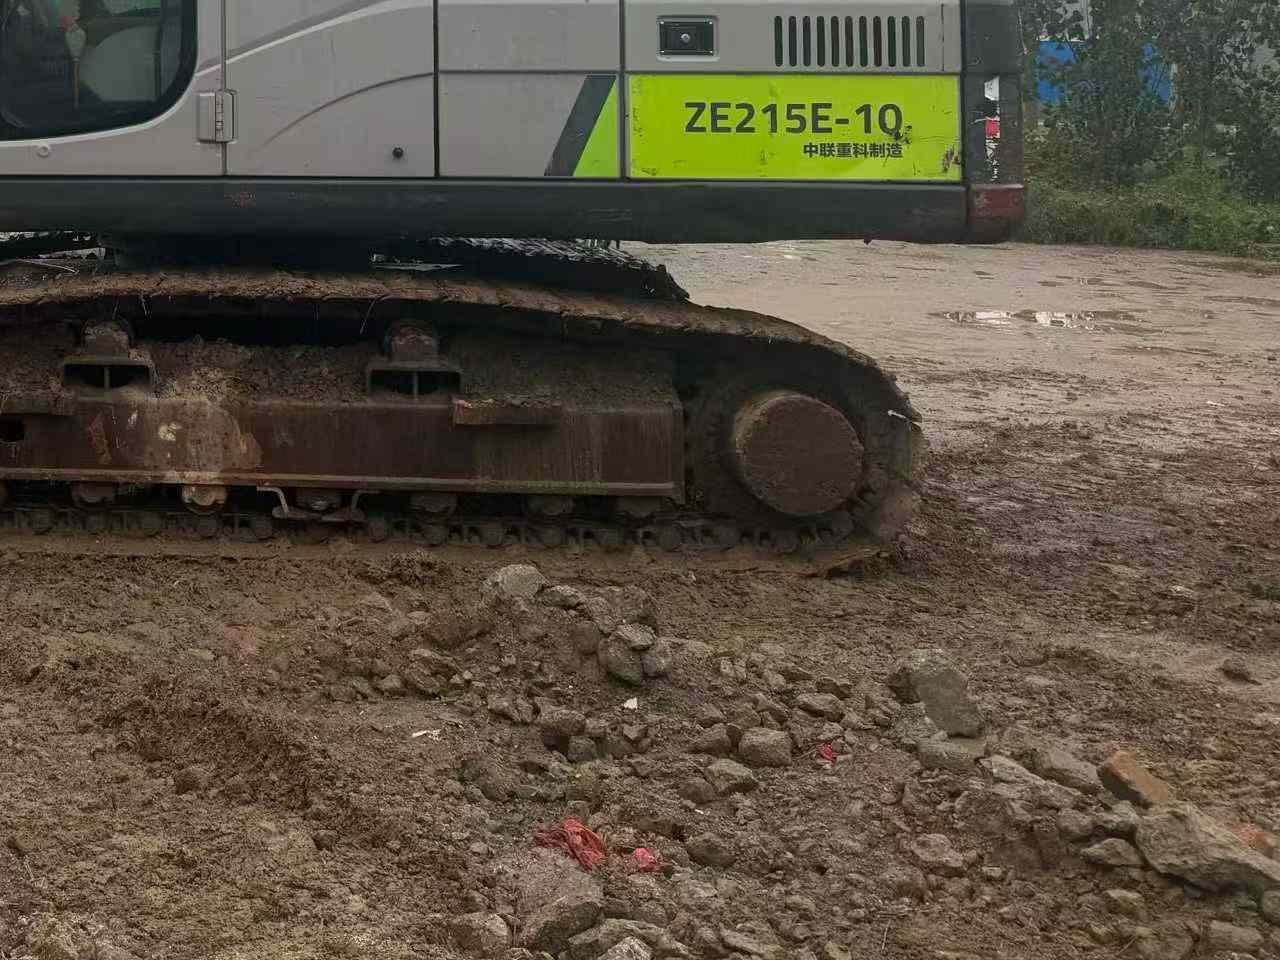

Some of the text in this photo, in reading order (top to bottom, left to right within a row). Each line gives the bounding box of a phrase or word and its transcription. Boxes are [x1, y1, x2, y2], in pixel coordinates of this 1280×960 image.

[803, 142, 903, 158] 中联重科制造
